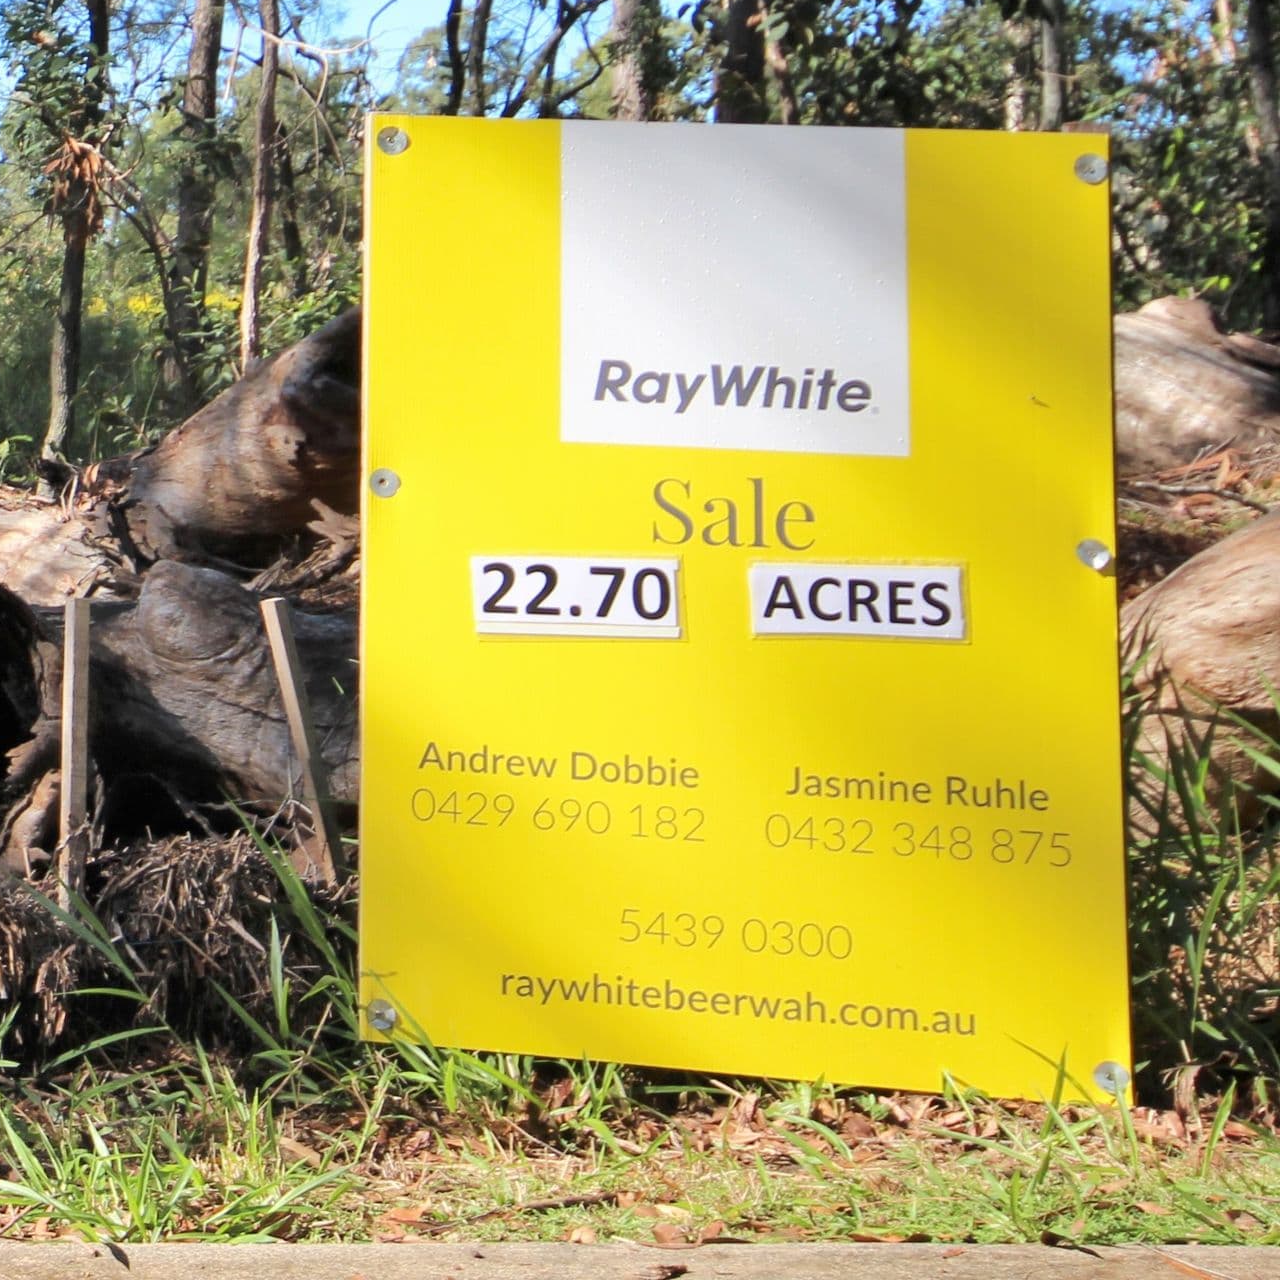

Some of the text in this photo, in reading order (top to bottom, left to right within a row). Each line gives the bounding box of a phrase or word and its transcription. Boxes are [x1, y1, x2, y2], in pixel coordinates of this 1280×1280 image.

[652, 478, 816, 551] Sale
[482, 563, 951, 626] 22.70 ACRES
[418, 741, 700, 789] Andrew Dobbie
[786, 766, 1050, 812] Jasmine Ruhle
[411, 787, 706, 843] 0429 690 182
[765, 814, 1072, 867] 0432 348 875
[619, 909, 853, 960] 5439 0300
[501, 969, 976, 1036] raywhitebeerwah.com.au
